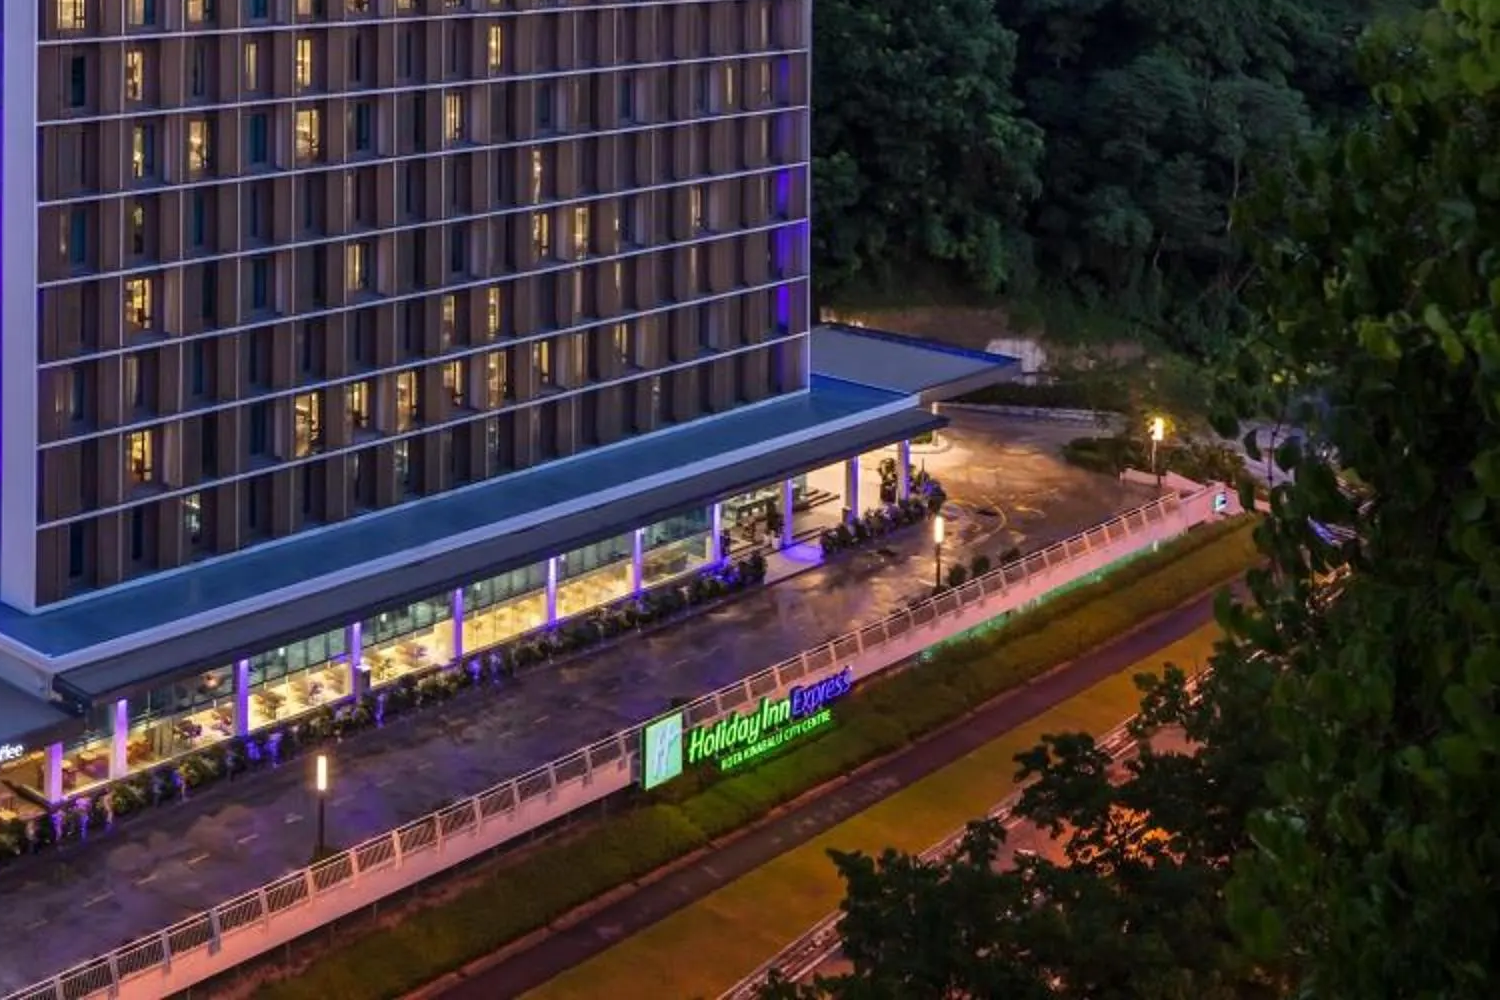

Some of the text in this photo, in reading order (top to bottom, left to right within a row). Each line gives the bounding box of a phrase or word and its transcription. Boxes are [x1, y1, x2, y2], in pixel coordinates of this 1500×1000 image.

[689, 668, 851, 763] Holiday Inn Express
[783, 723, 801, 741] CITY
[801, 709, 831, 732] CENTRE
